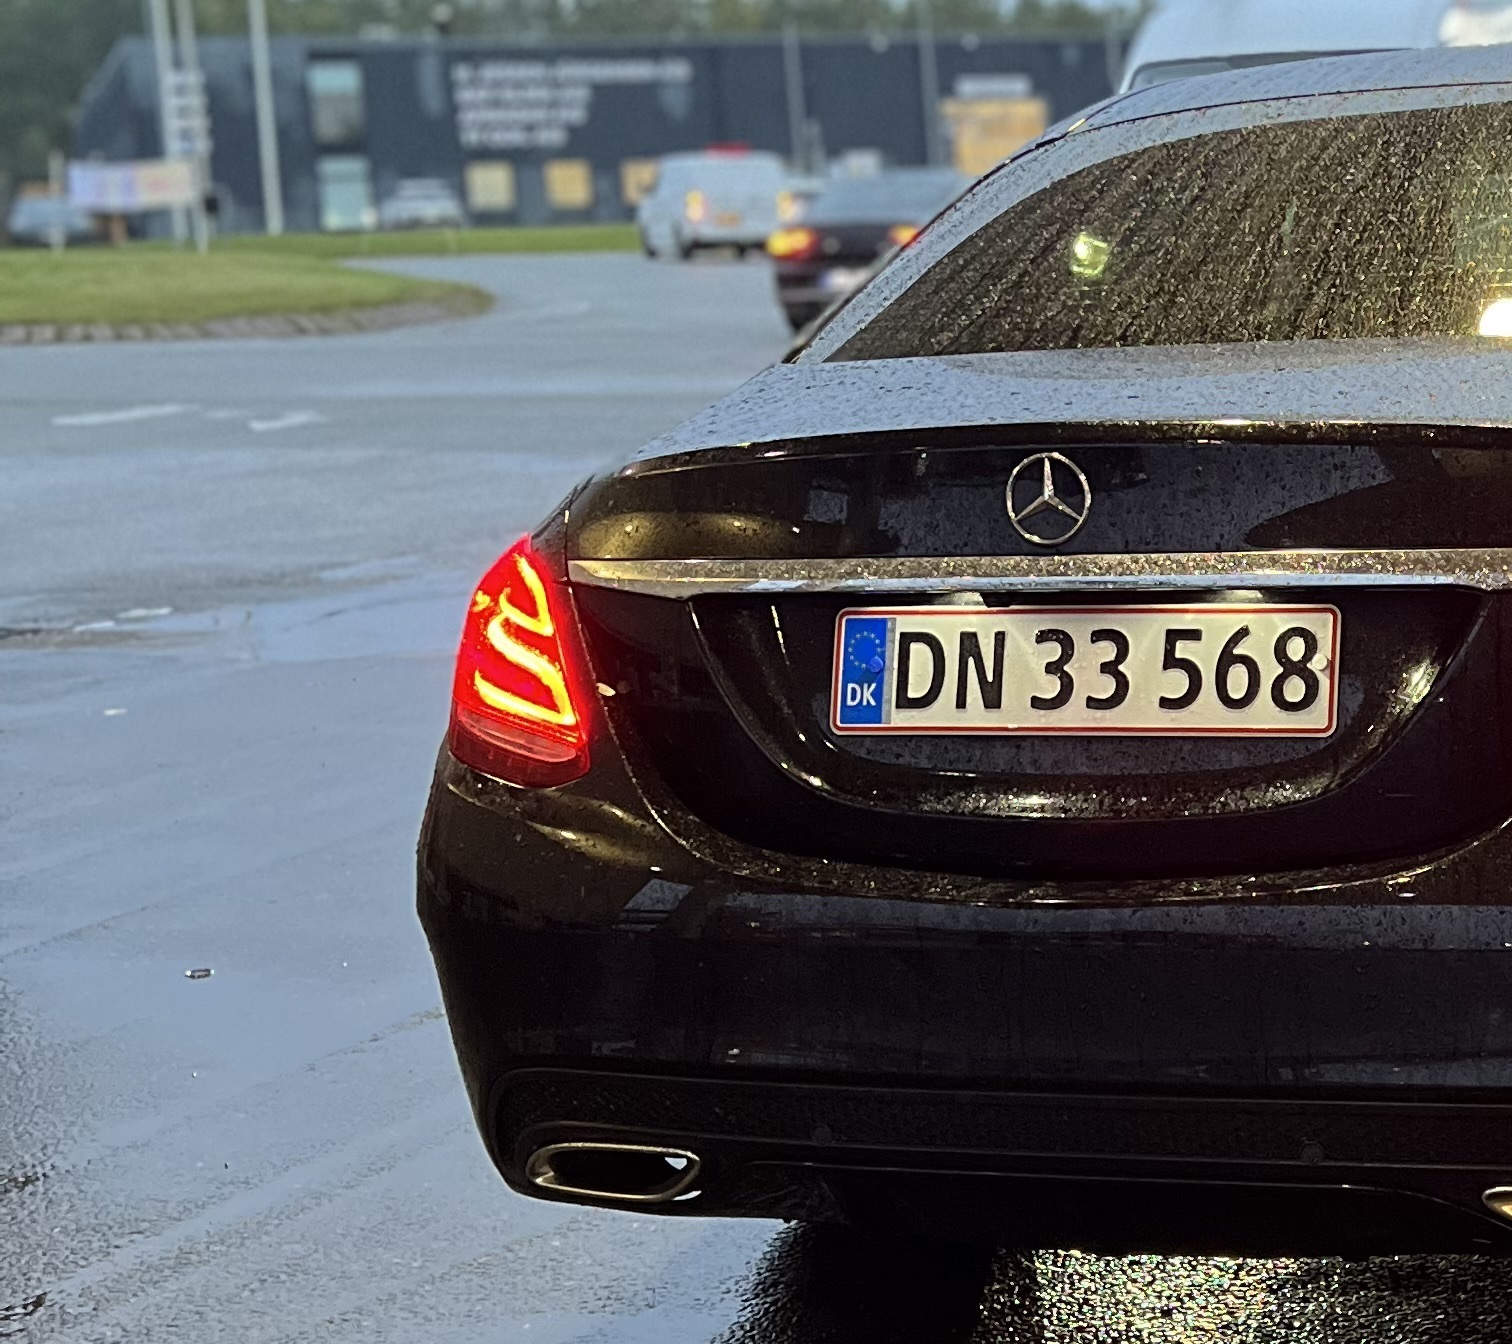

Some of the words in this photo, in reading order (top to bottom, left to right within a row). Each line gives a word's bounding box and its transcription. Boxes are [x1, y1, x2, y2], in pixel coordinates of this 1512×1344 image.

[846, 682, 877, 708] DK
[894, 630, 1006, 711] DN
[1029, 627, 1130, 712] 33
[1157, 624, 1321, 713] 568
